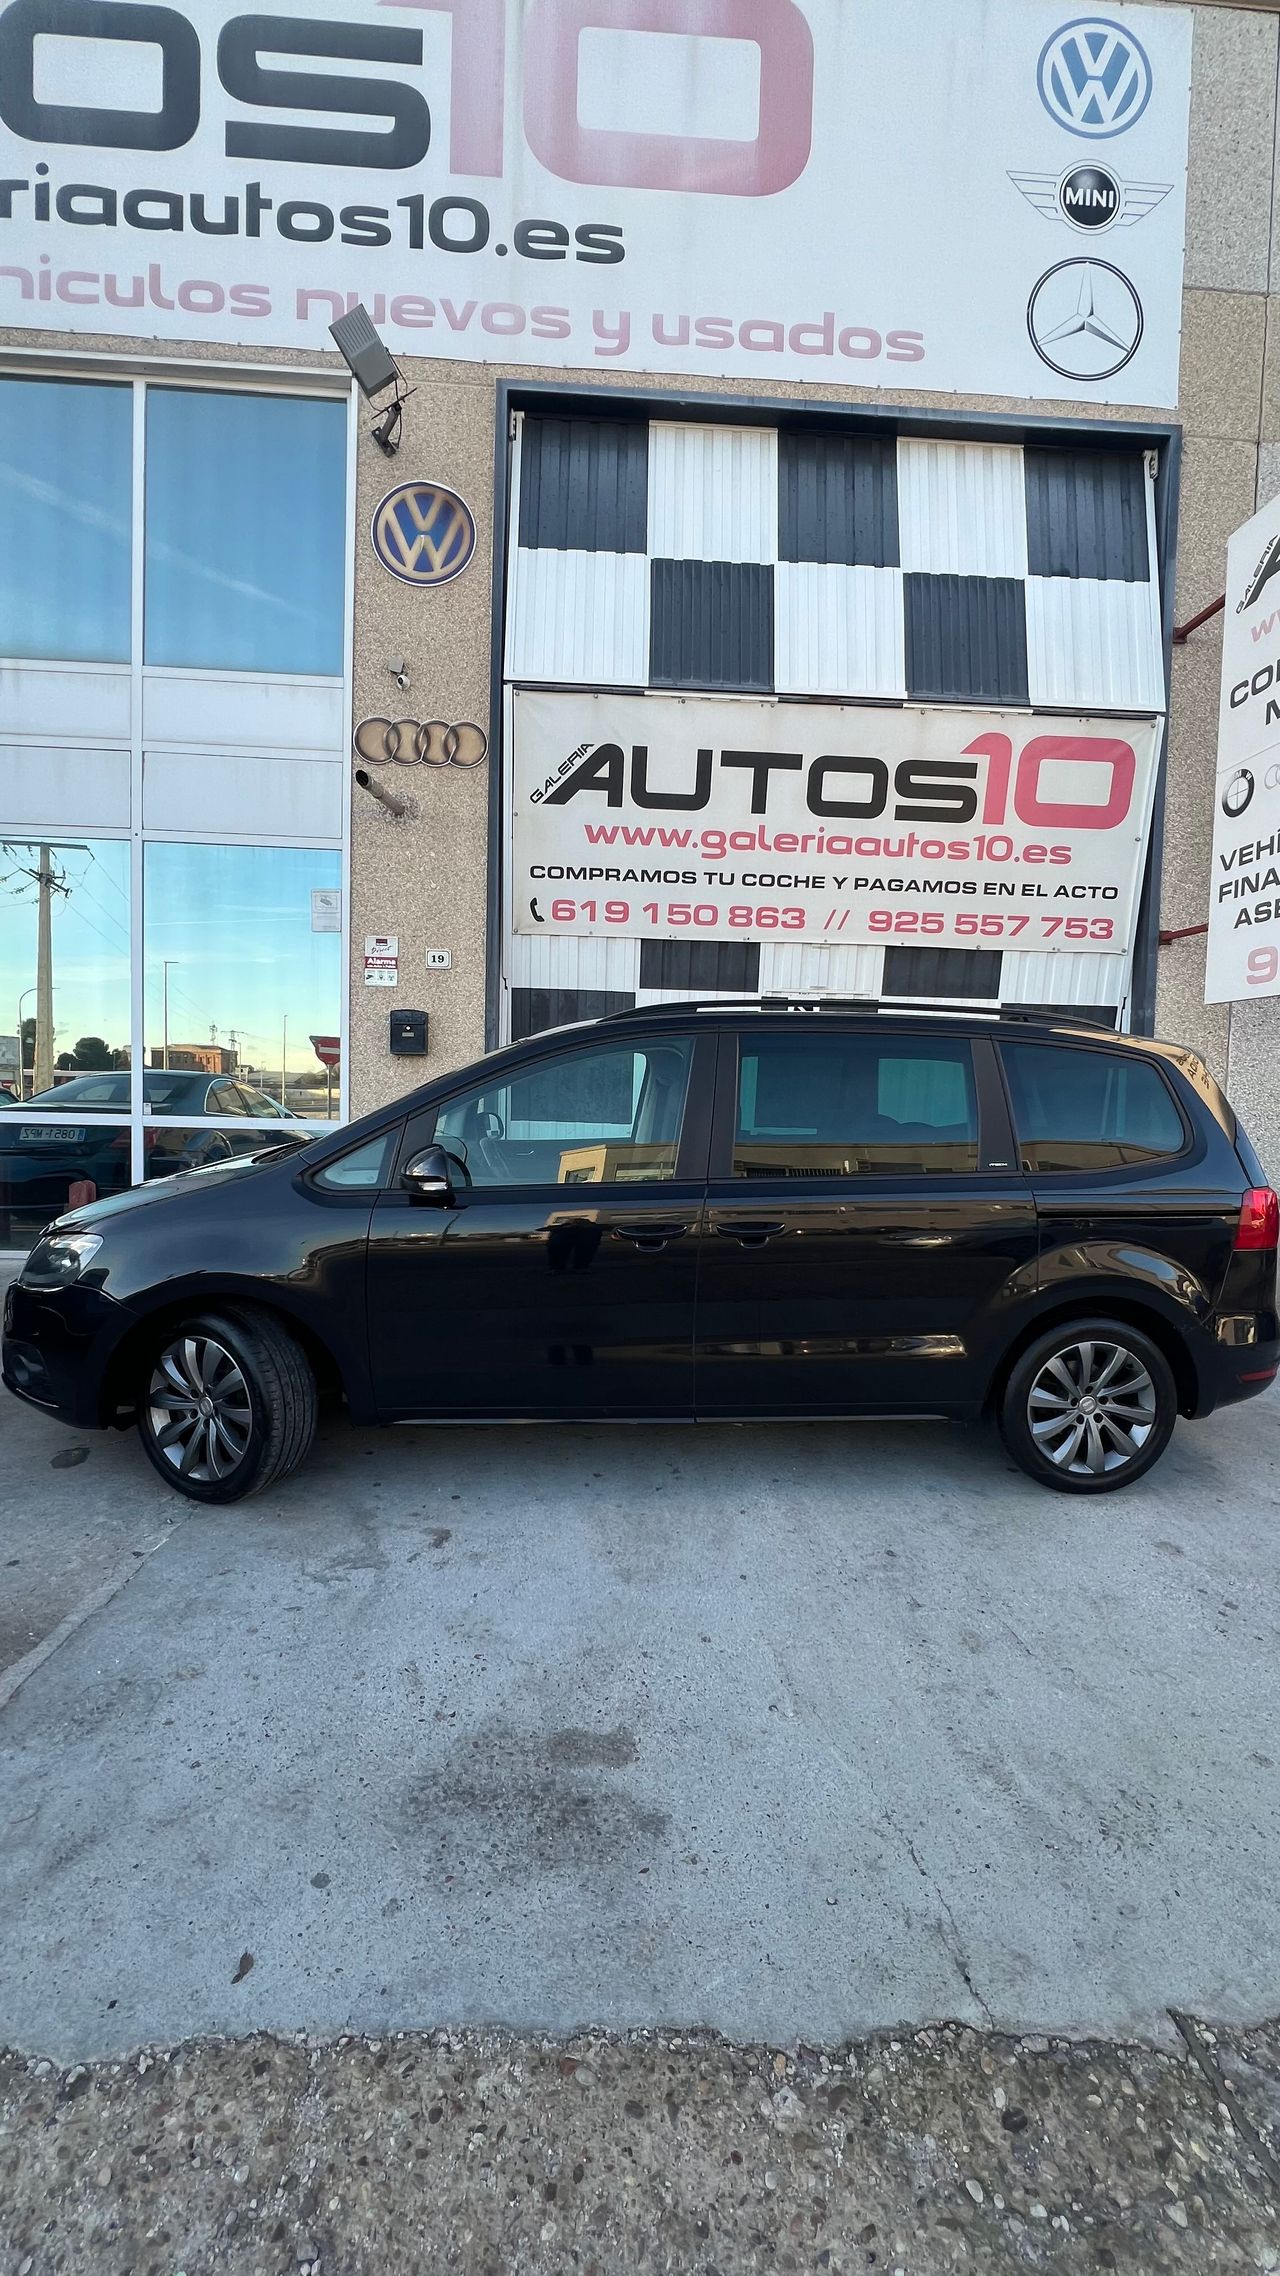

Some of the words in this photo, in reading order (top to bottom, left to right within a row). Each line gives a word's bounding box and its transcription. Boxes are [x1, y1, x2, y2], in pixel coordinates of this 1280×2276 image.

[1066, 186, 1115, 209] MINI
[296, 288, 572, 340] nuevos
[592, 309, 631, 357] y
[652, 312, 926, 363] usados
[1235, 534, 1278, 615] GALERIA
[529, 743, 595, 804] GALERIA
[541, 732, 1136, 830] AUTOS10
[584, 824, 1073, 865] www.galeriaautos10.es
[529, 865, 697, 885] COMPRAMOS
[703, 872, 735, 886] TU
[741, 873, 825, 890] COCHE
[832, 877, 849, 891] Y
[853, 877, 978, 895] PAGAMOS
[983, 882, 1016, 896] EN
[1021, 883, 1048, 897] EL
[1053, 885, 1119, 899] ACTO
[551, 899, 631, 924] 619
[642, 902, 719, 926] 150
[727, 906, 806, 930] 863
[823, 909, 851, 930] //
[868, 910, 945, 934] 925
[954, 913, 1030, 937] 557
[1040, 917, 1114, 940] 753
[367, 957, 396, 965] Alarma
[431, 954, 445, 964] 19
[1246, 945, 1279, 985] 9
